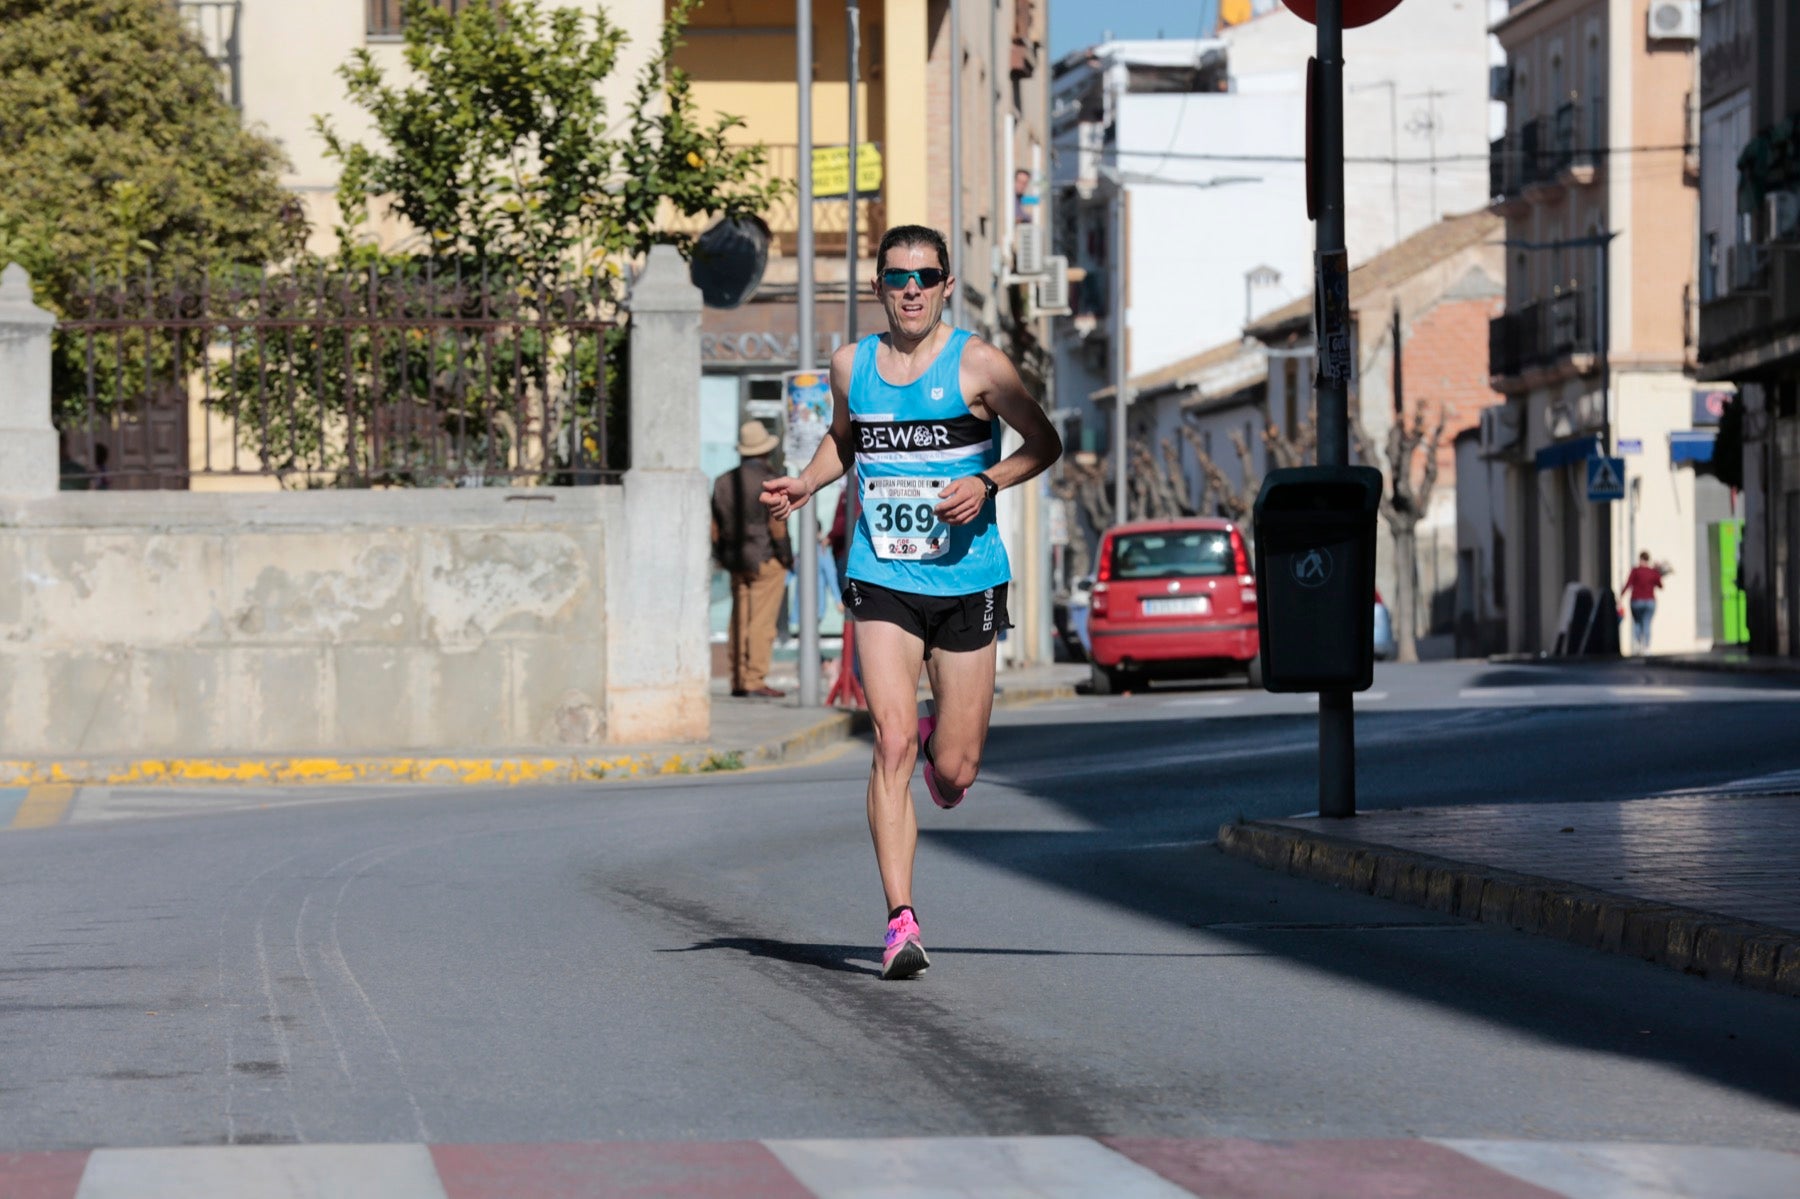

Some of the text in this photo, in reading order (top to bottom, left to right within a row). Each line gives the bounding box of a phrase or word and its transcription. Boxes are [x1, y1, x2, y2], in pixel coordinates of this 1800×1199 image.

[861, 424, 950, 449] BEWOR
[883, 480, 896, 488] GRAN
[896, 480, 917, 488] PREMIO
[917, 480, 924, 488] DE
[926, 480, 945, 488] FOO
[874, 503, 935, 533] 369
